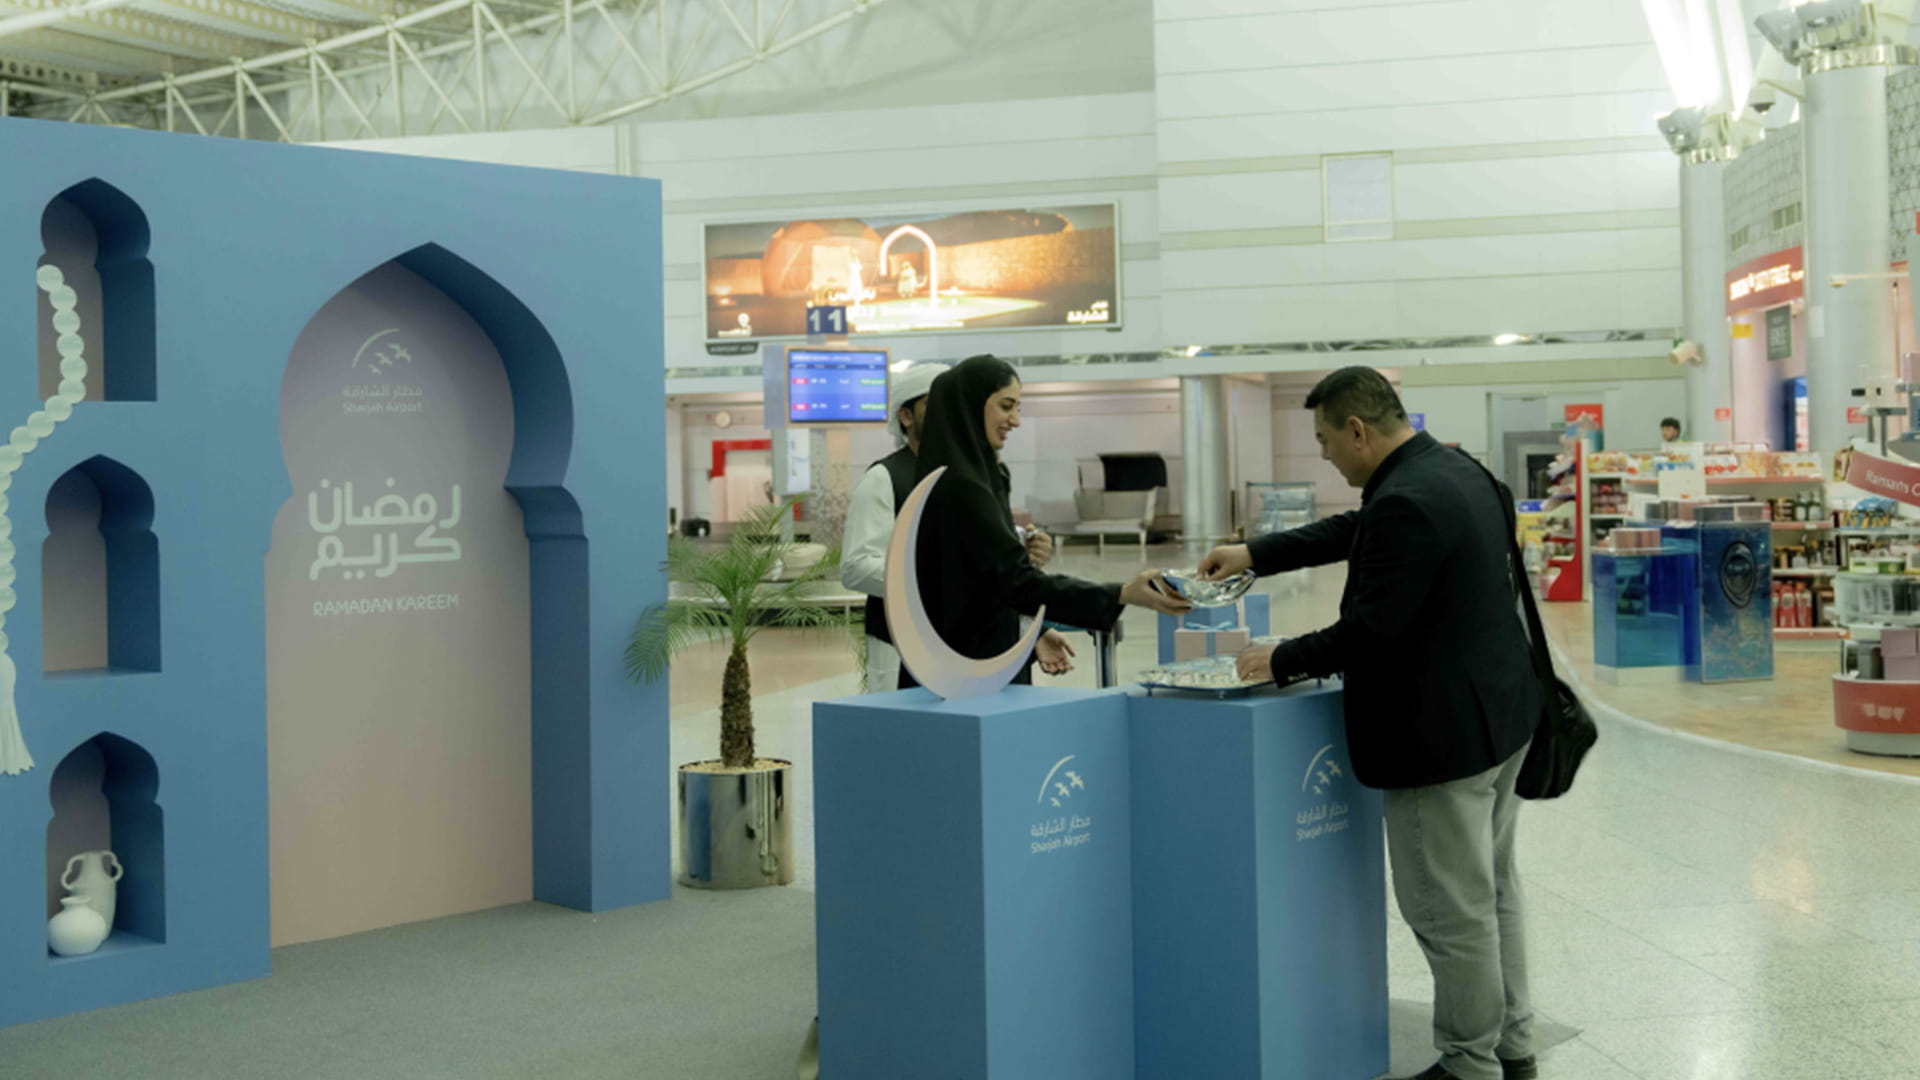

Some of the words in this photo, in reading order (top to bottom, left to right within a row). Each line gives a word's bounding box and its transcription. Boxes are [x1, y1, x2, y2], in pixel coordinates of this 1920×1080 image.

[809, 308, 843, 332] 11
[308, 477, 461, 534] رمضان
[309, 524, 462, 581] كريم
[313, 597, 393, 617] RAMADAN
[396, 593, 460, 611] KAREEM
[1030, 815, 1065, 838] الشارقة
[1068, 814, 1091, 833] مطار
[1030, 837, 1061, 855] Sharjah
[1062, 831, 1091, 848] Airport
